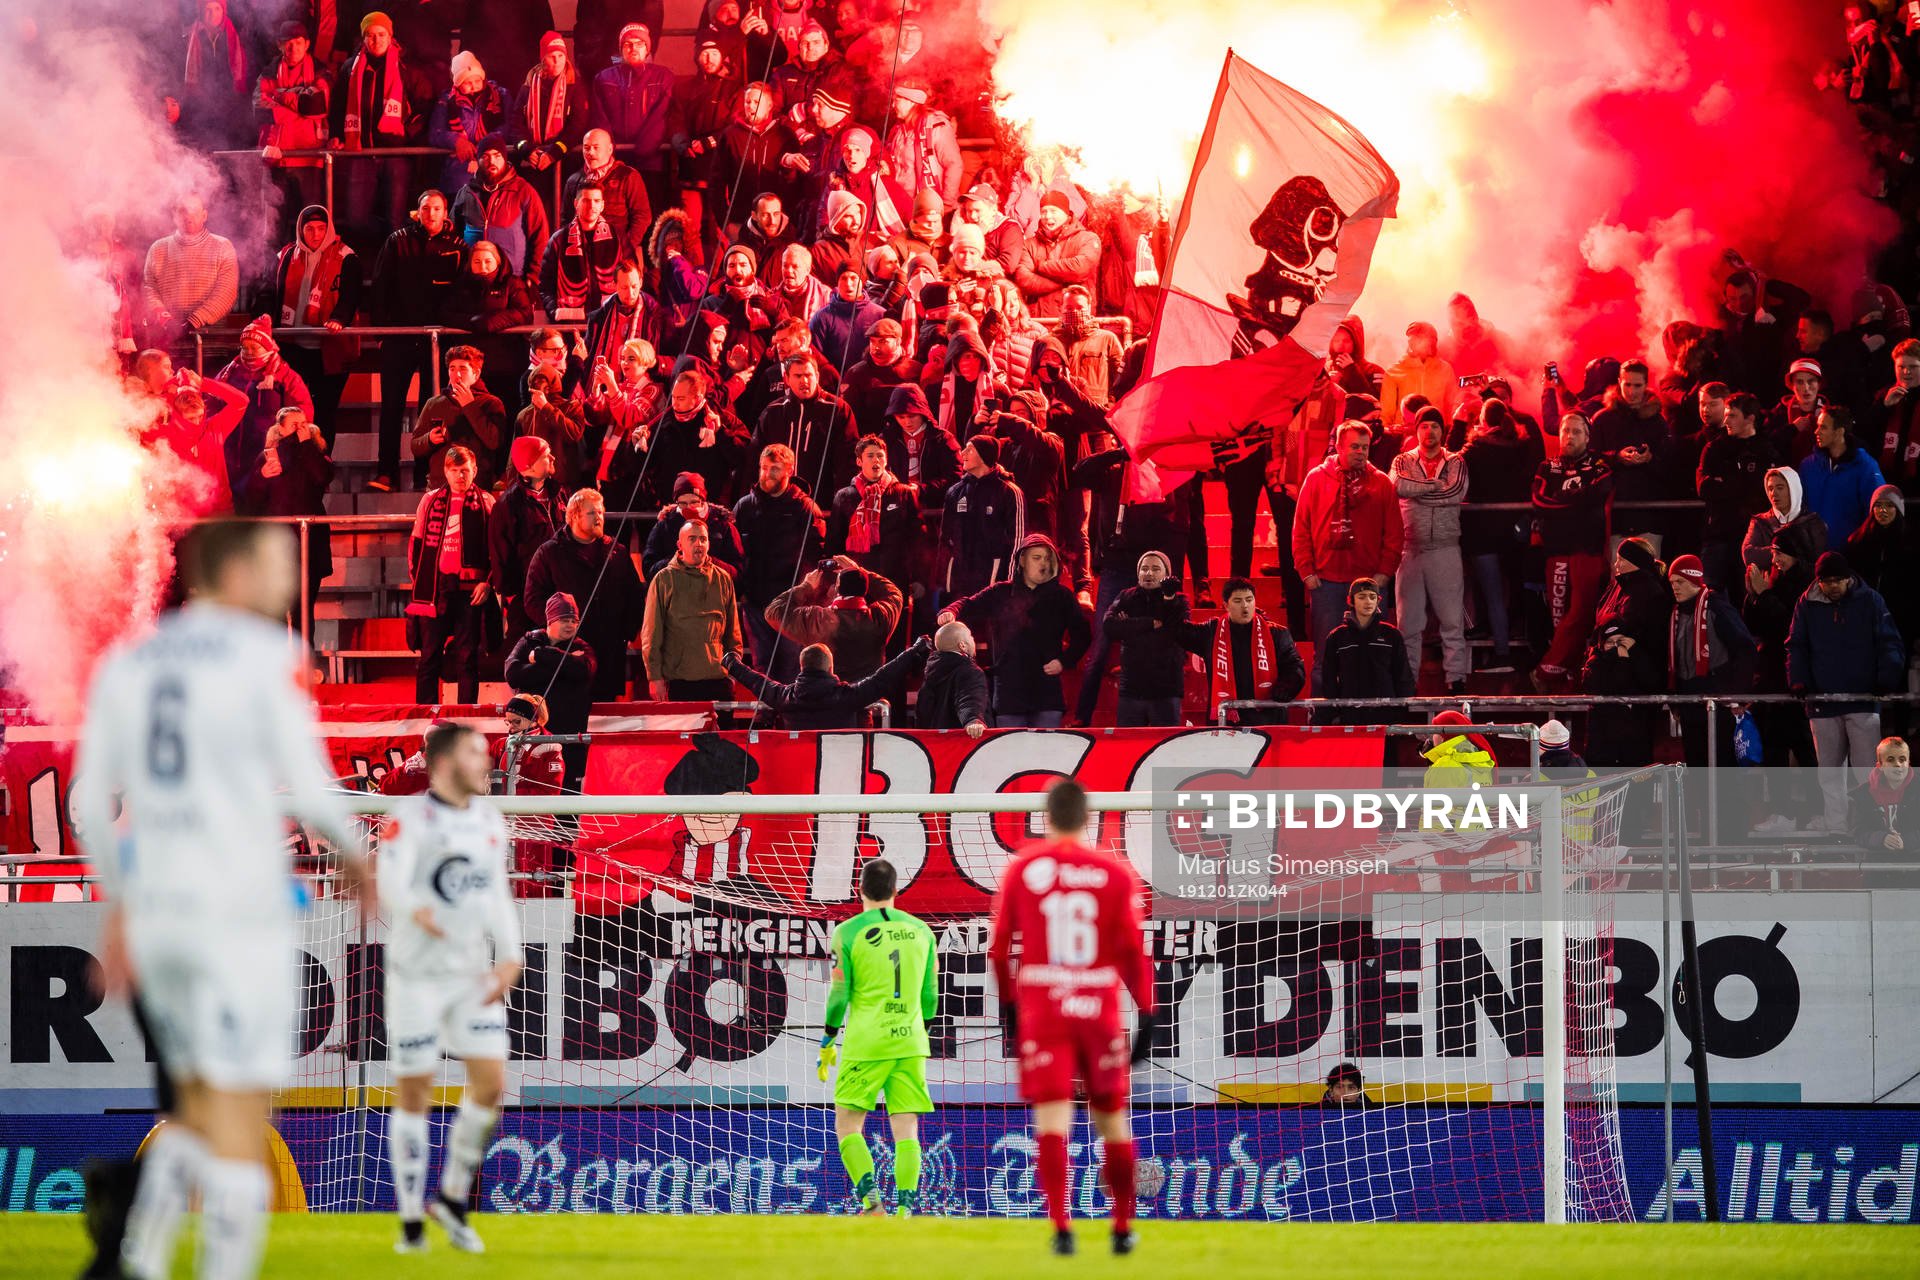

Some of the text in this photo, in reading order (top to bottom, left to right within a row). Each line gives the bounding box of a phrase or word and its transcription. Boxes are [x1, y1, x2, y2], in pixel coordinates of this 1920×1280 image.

[147, 670, 190, 788] 6
[671, 917, 838, 956] BERGEN
[1040, 890, 1098, 967] 16
[889, 949, 901, 999] 1
[1645, 1142, 1919, 1223] Alltid
